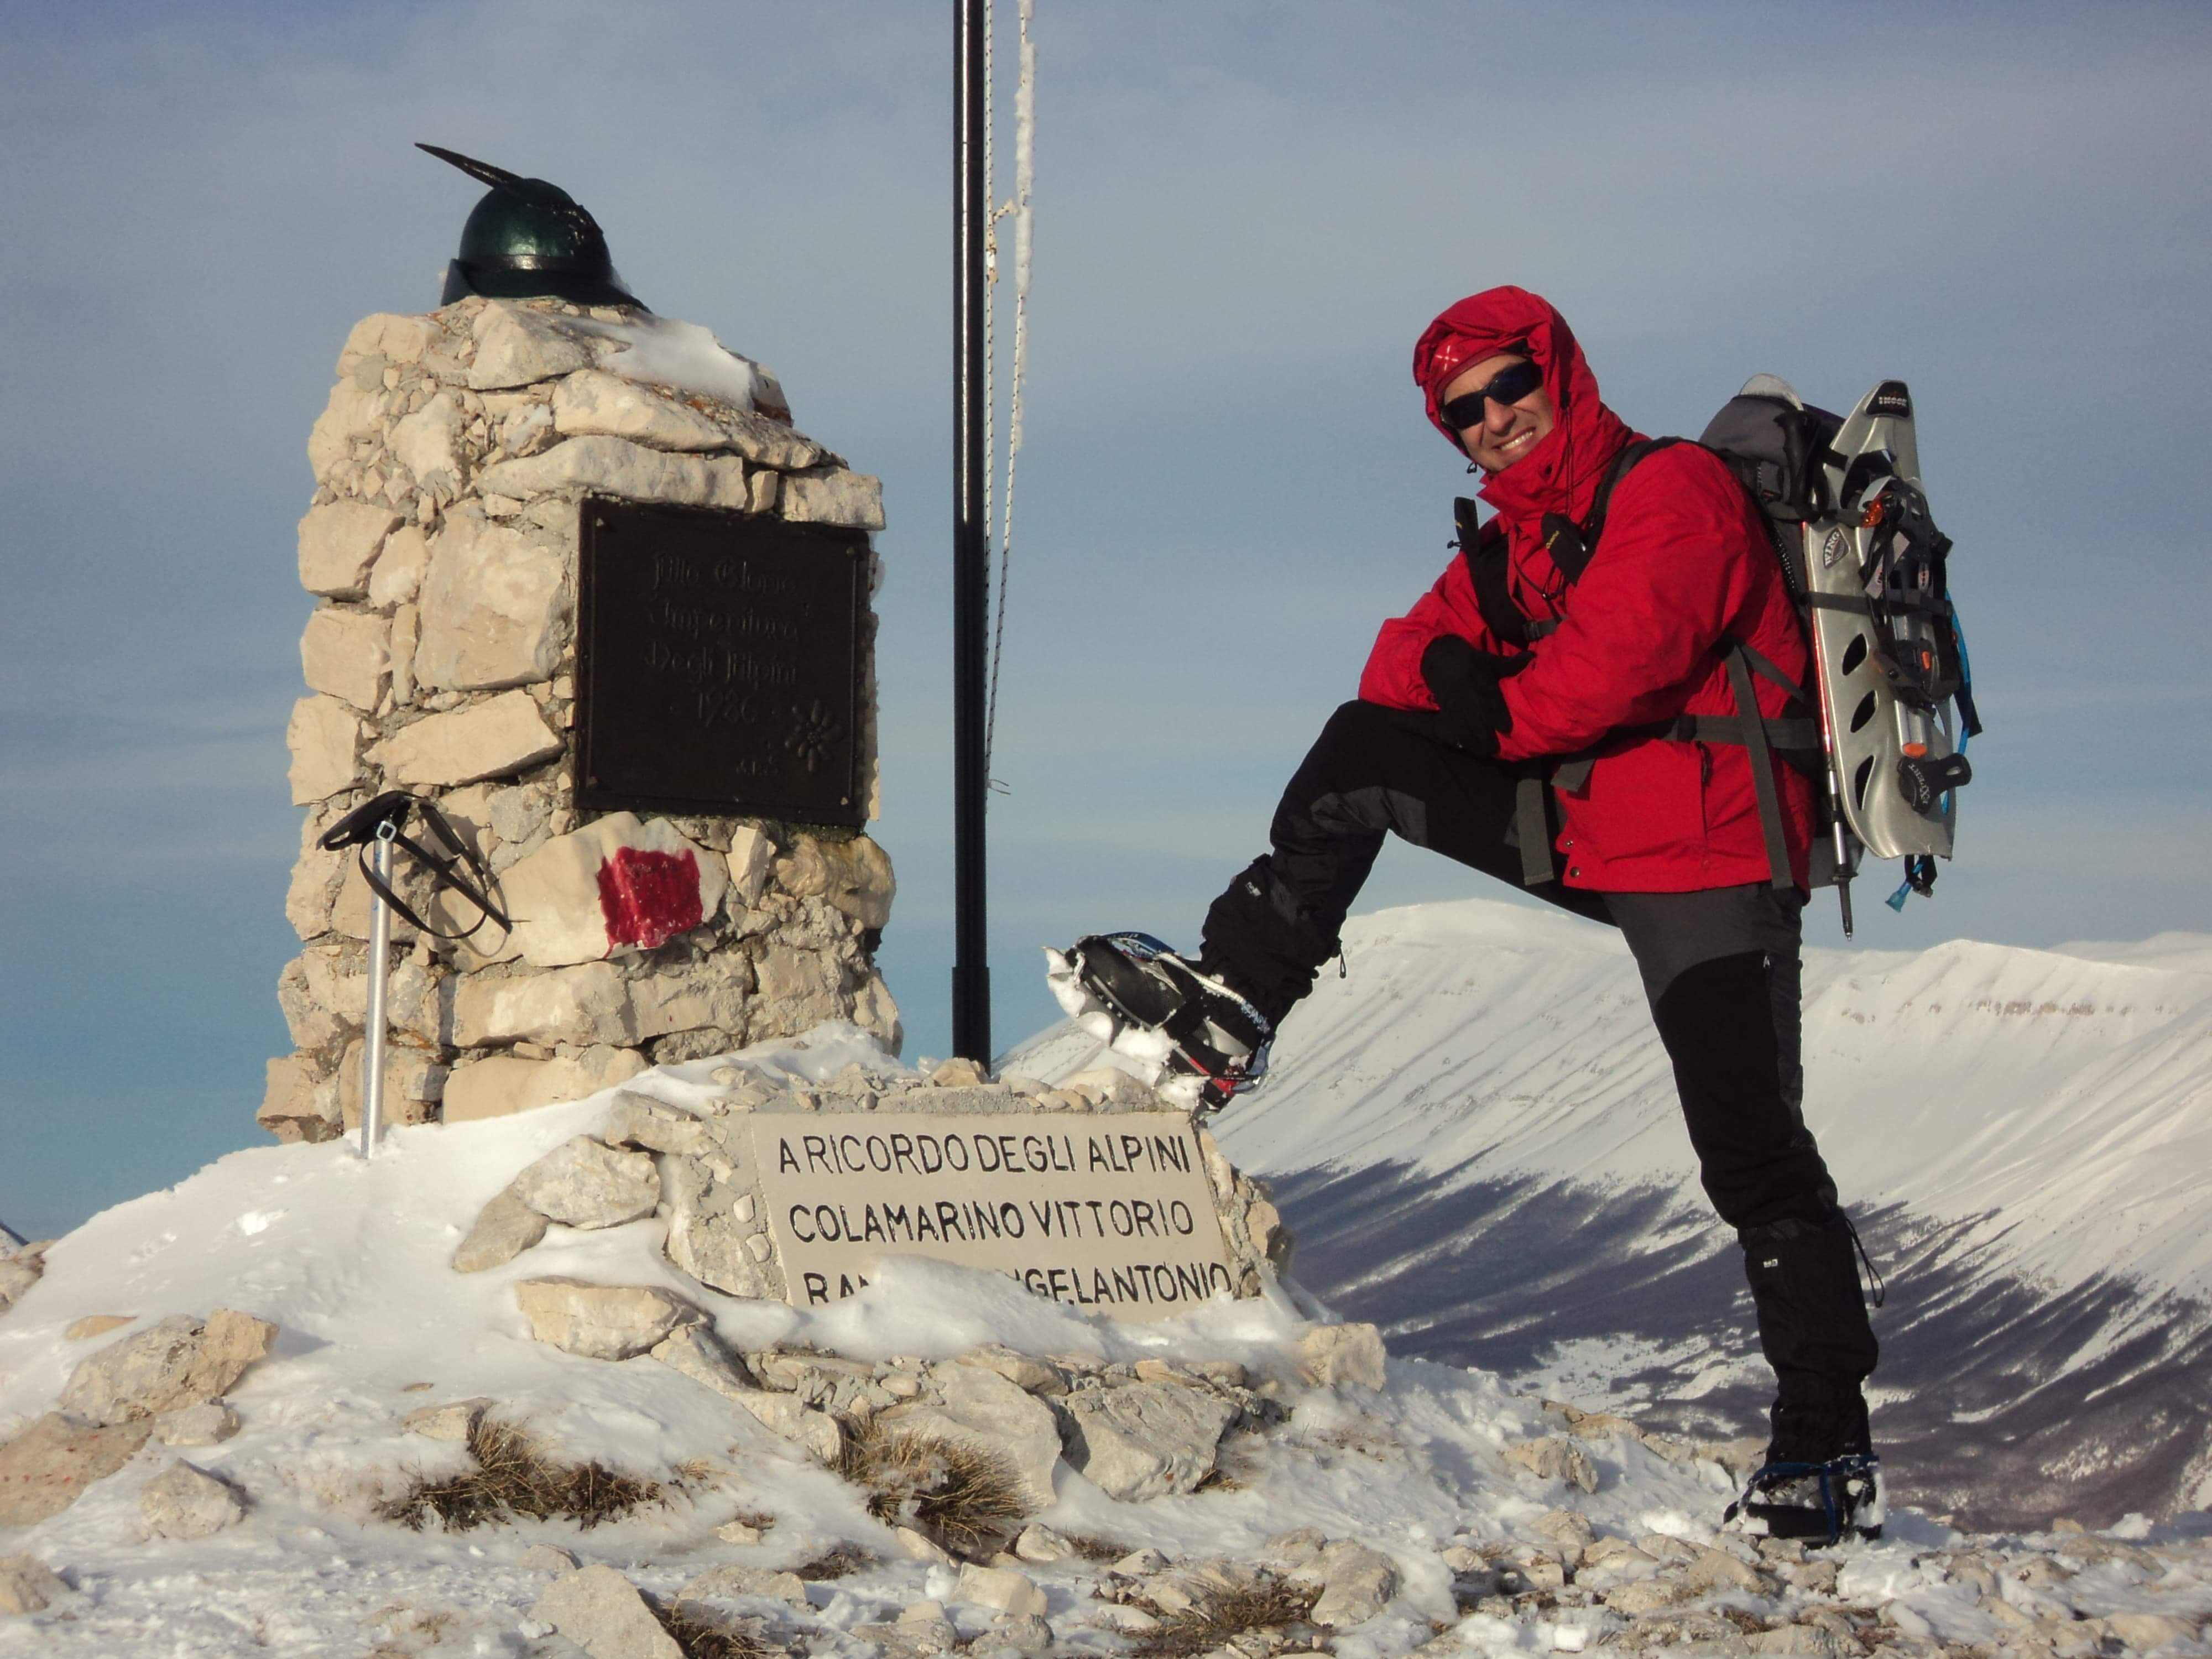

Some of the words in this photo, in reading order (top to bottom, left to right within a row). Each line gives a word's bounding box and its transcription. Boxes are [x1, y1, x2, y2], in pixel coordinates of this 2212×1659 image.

[1824, 531, 1840, 566] WING
[779, 1138, 801, 1174] A
[804, 1134, 969, 1175] RICORDO
[973, 1135, 1076, 1173] DEGLI
[1088, 1135, 1191, 1173] ALPINI
[789, 1201, 1025, 1243] COLAMARINO
[1029, 1199, 1193, 1239] VITTORIO
[1014, 1262, 1233, 1305] GELANTONIO
